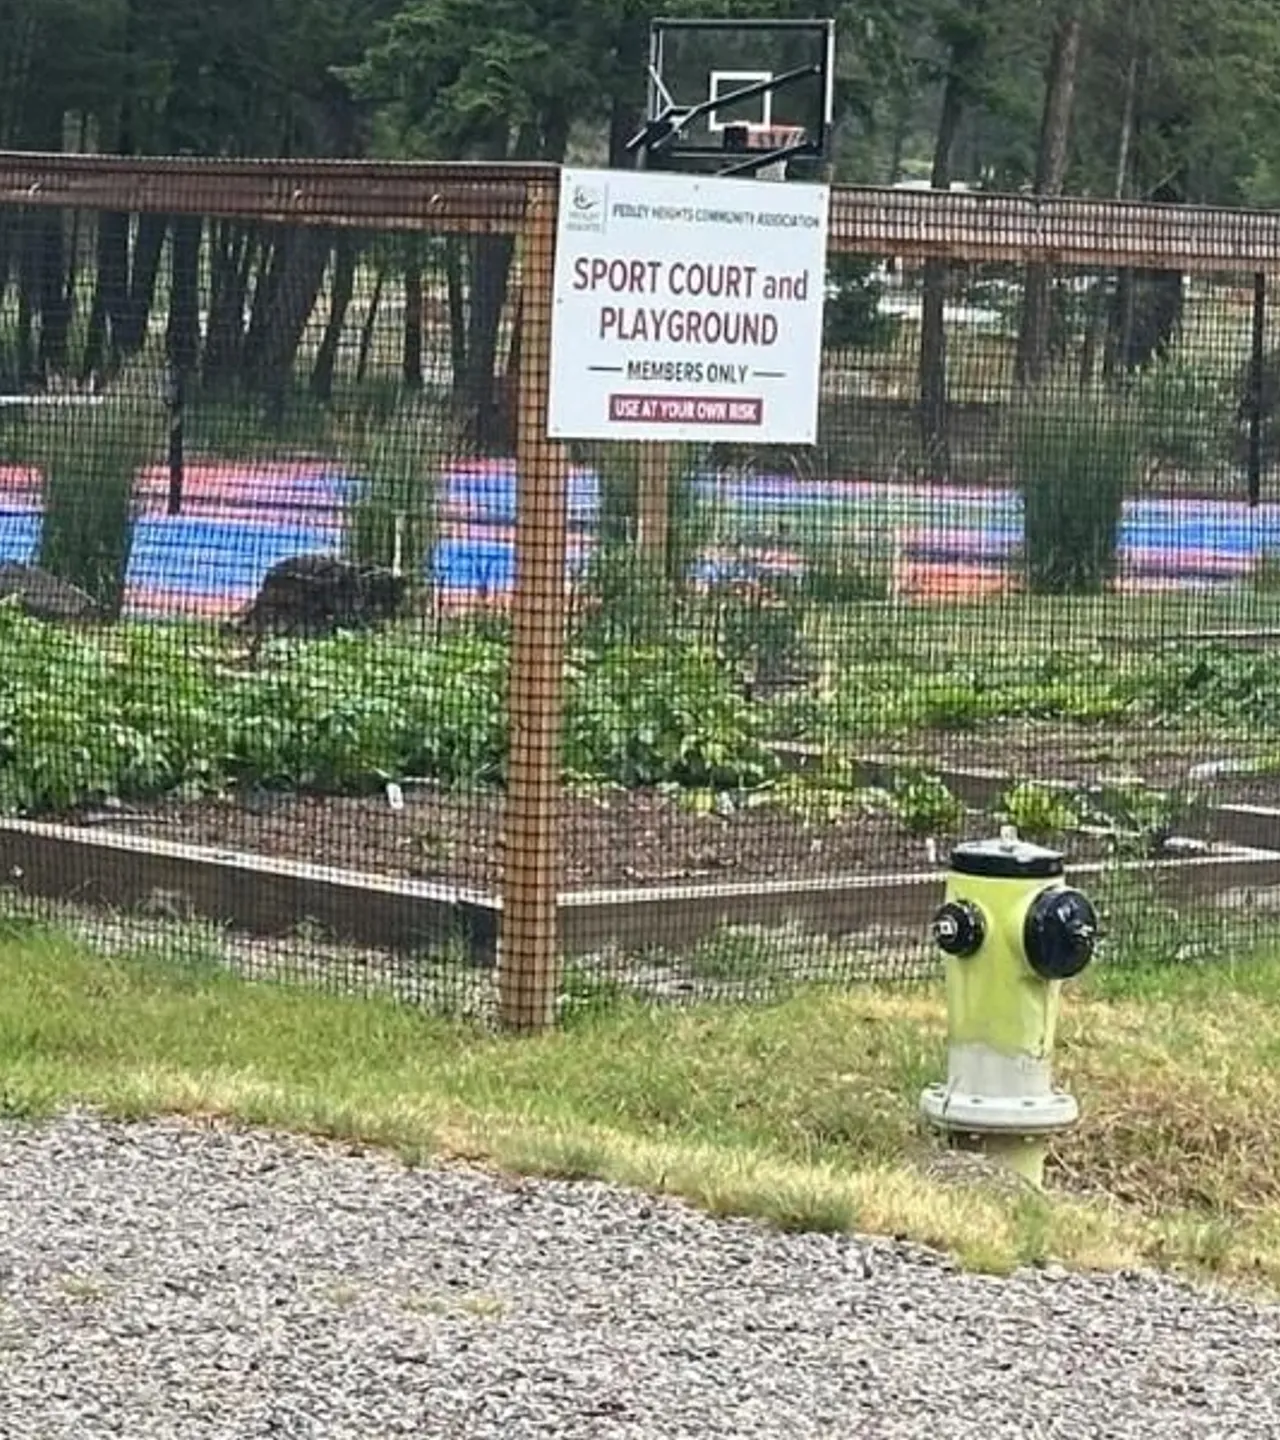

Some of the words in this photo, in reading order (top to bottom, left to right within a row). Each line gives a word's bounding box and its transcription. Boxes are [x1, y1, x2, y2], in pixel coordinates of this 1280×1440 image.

[651, 206, 693, 223] HEIGHTS
[695, 208, 755, 227] COMMUNITY
[757, 211, 820, 229] ASSOCIATION
[572, 257, 661, 295] SPORT
[668, 262, 757, 299] COURT
[762, 270, 809, 301] and
[599, 306, 779, 347] PLAYGROUND
[627, 360, 704, 383] MEMBERS
[707, 363, 749, 384] ONLY
[615, 400, 641, 417] USE
[642, 401, 658, 417] AT
[660, 402, 695, 419] YOUR
[697, 403, 728, 421] OWN
[729, 404, 758, 422] RISK
